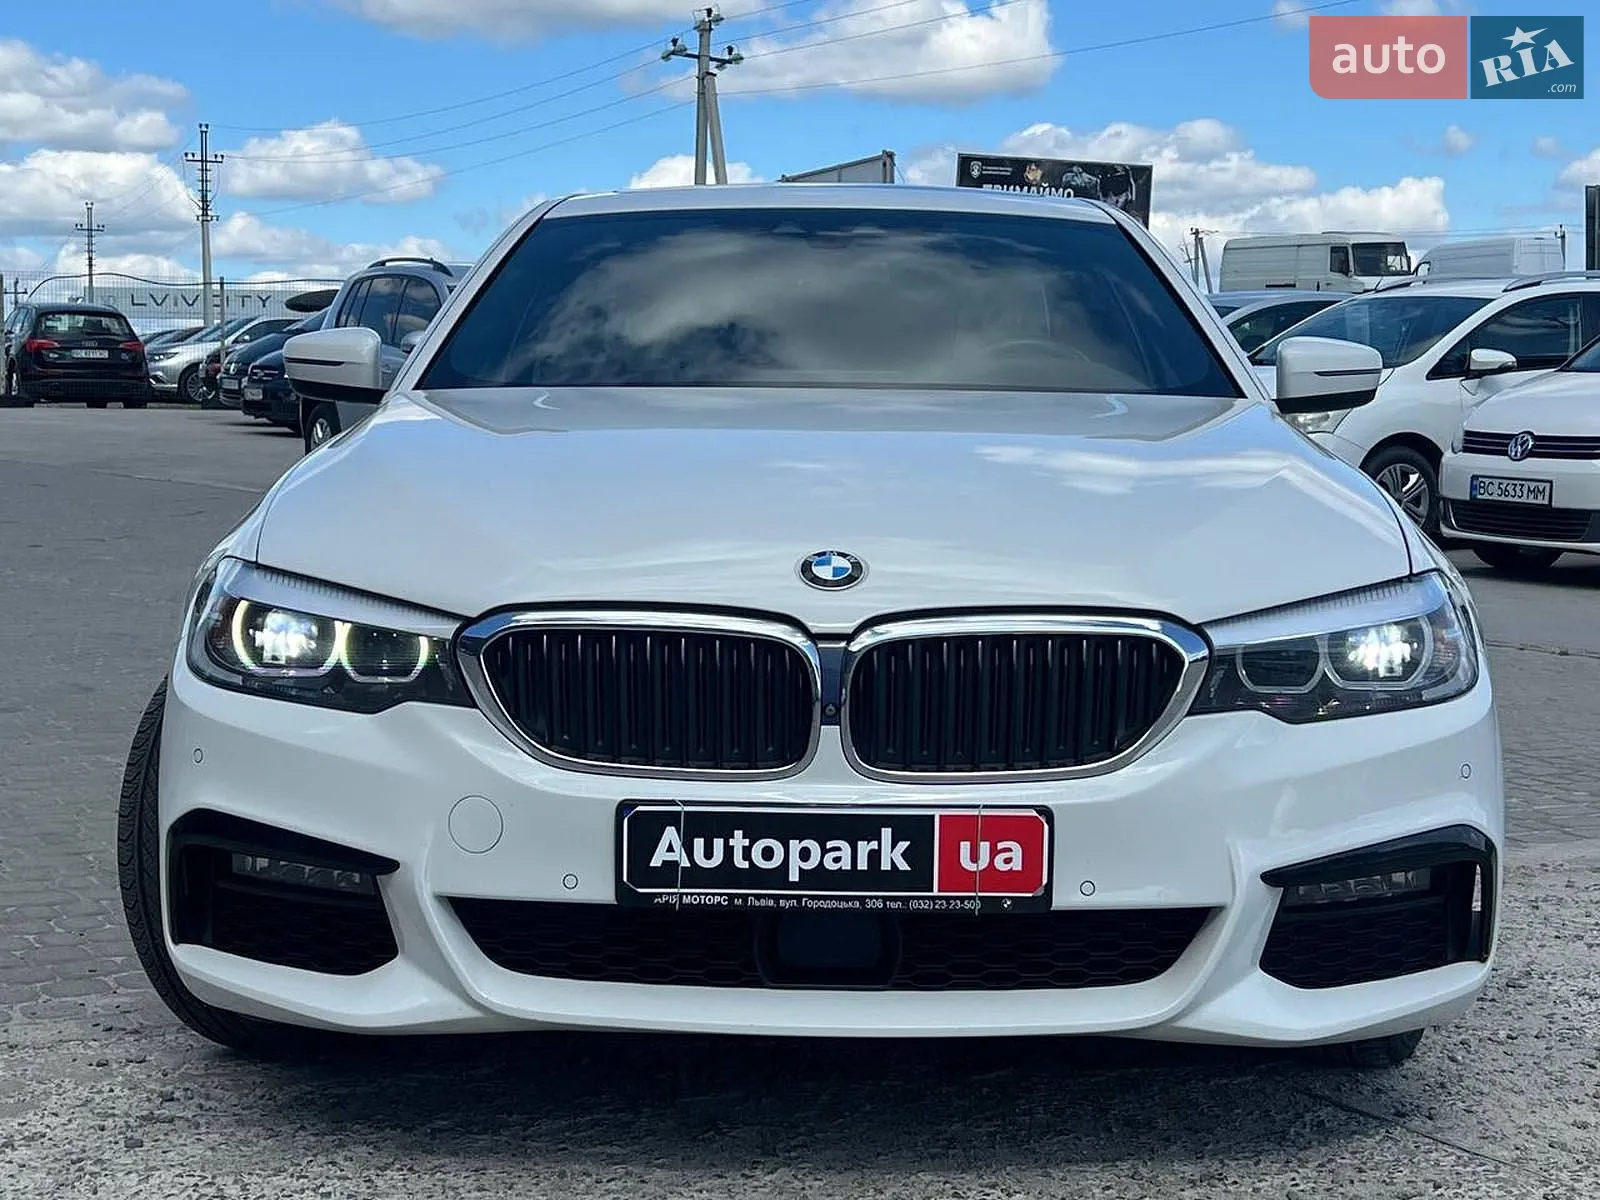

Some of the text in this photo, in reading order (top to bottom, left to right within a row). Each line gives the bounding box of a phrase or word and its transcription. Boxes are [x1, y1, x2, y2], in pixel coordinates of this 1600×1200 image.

[1478, 481, 1546, 500] BC 5633 MM
[649, 826, 1023, 882] Autopark ua
[682, 895, 729, 906] МОТОРС
[865, 898, 883, 908] 306
[909, 899, 933, 910] (032)
